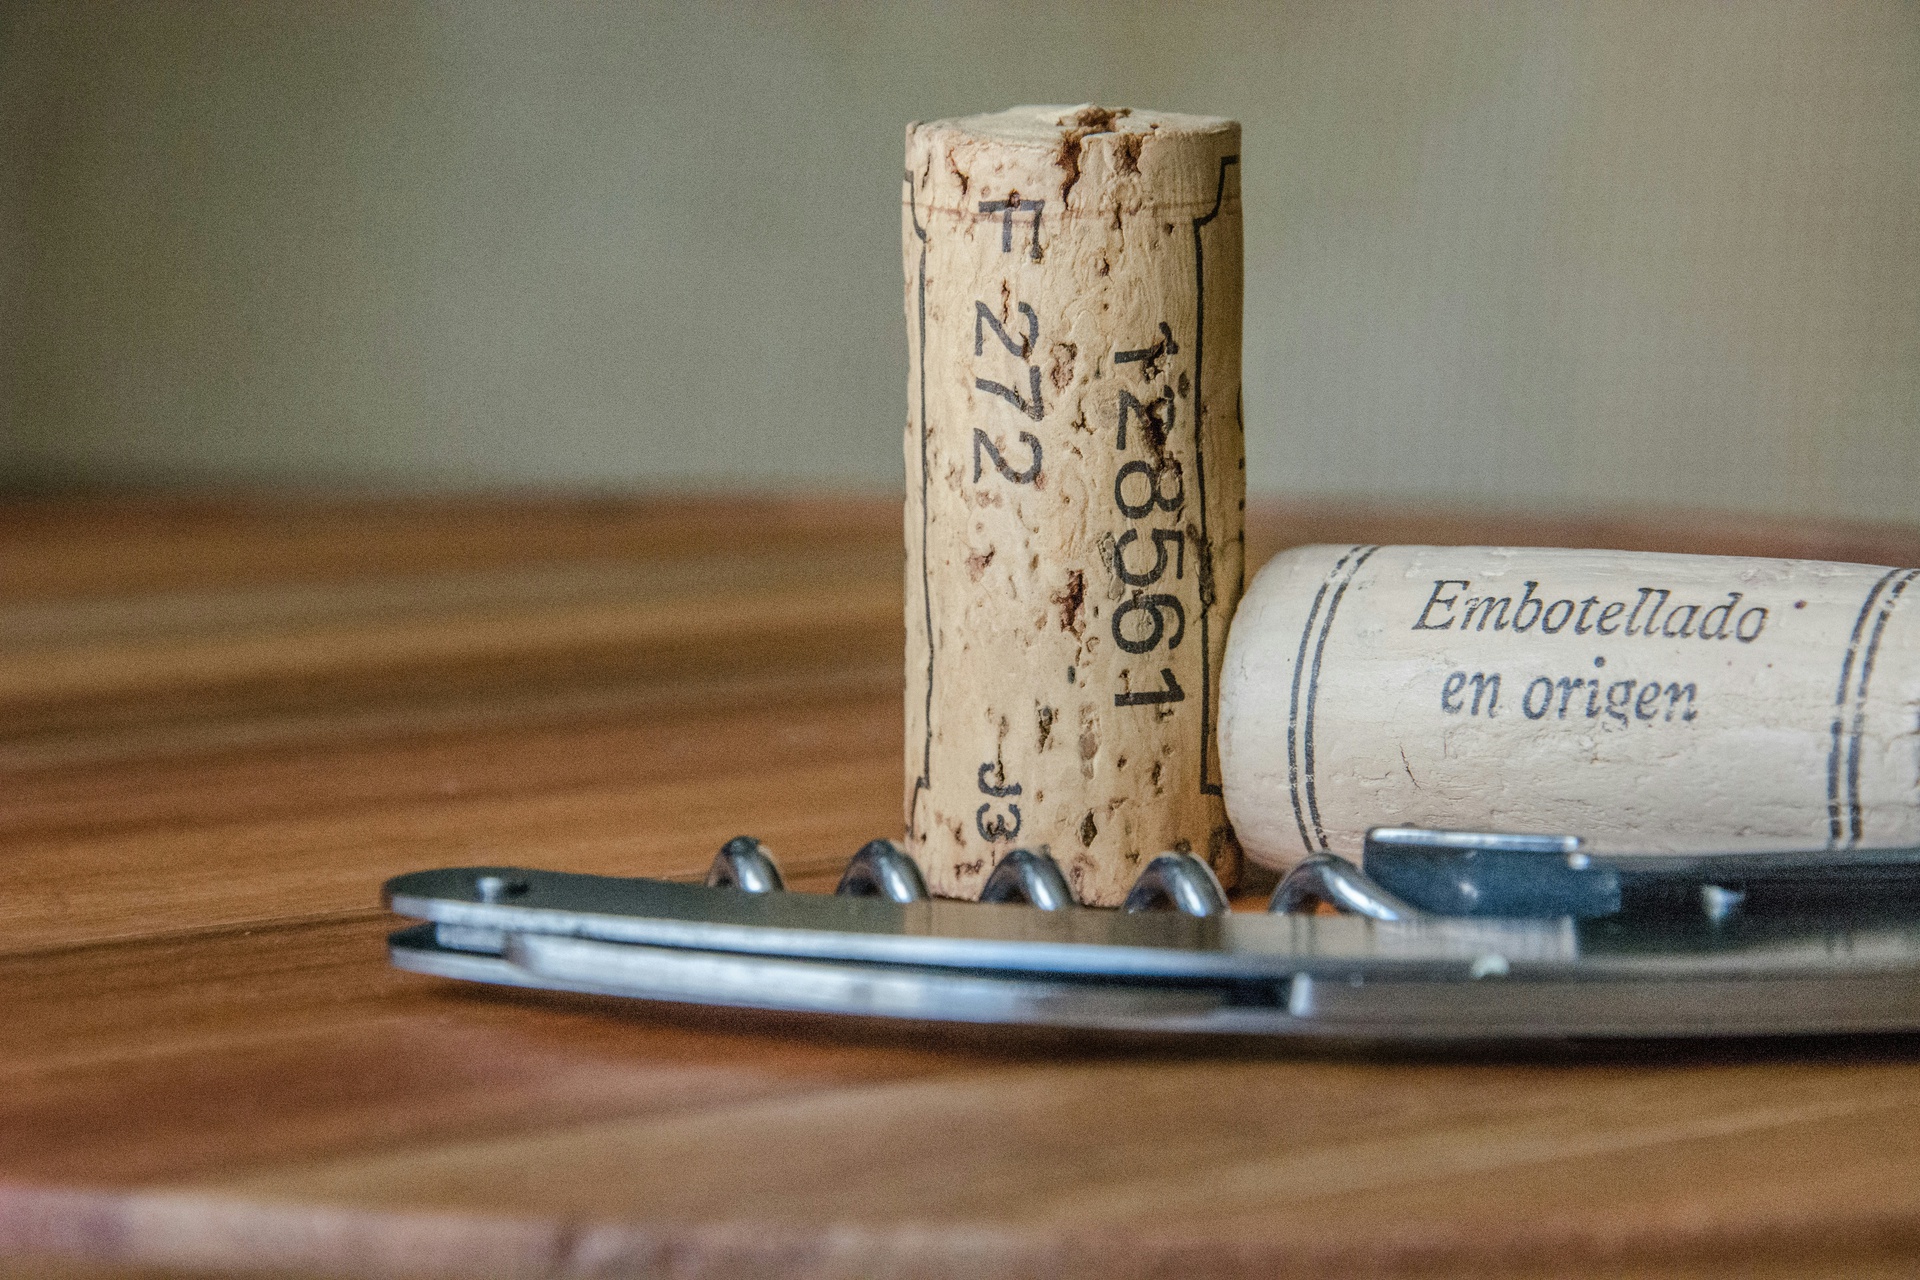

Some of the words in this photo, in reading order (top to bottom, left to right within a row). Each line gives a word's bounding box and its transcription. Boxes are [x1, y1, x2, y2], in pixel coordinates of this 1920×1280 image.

[978, 198, 1045, 260] F
[974, 300, 1045, 485] 272
[1112, 321, 1187, 708] 128561
[1411, 579, 1770, 644] Embotellado
[1441, 668, 1503, 719] en
[1521, 656, 1699, 731] origen
